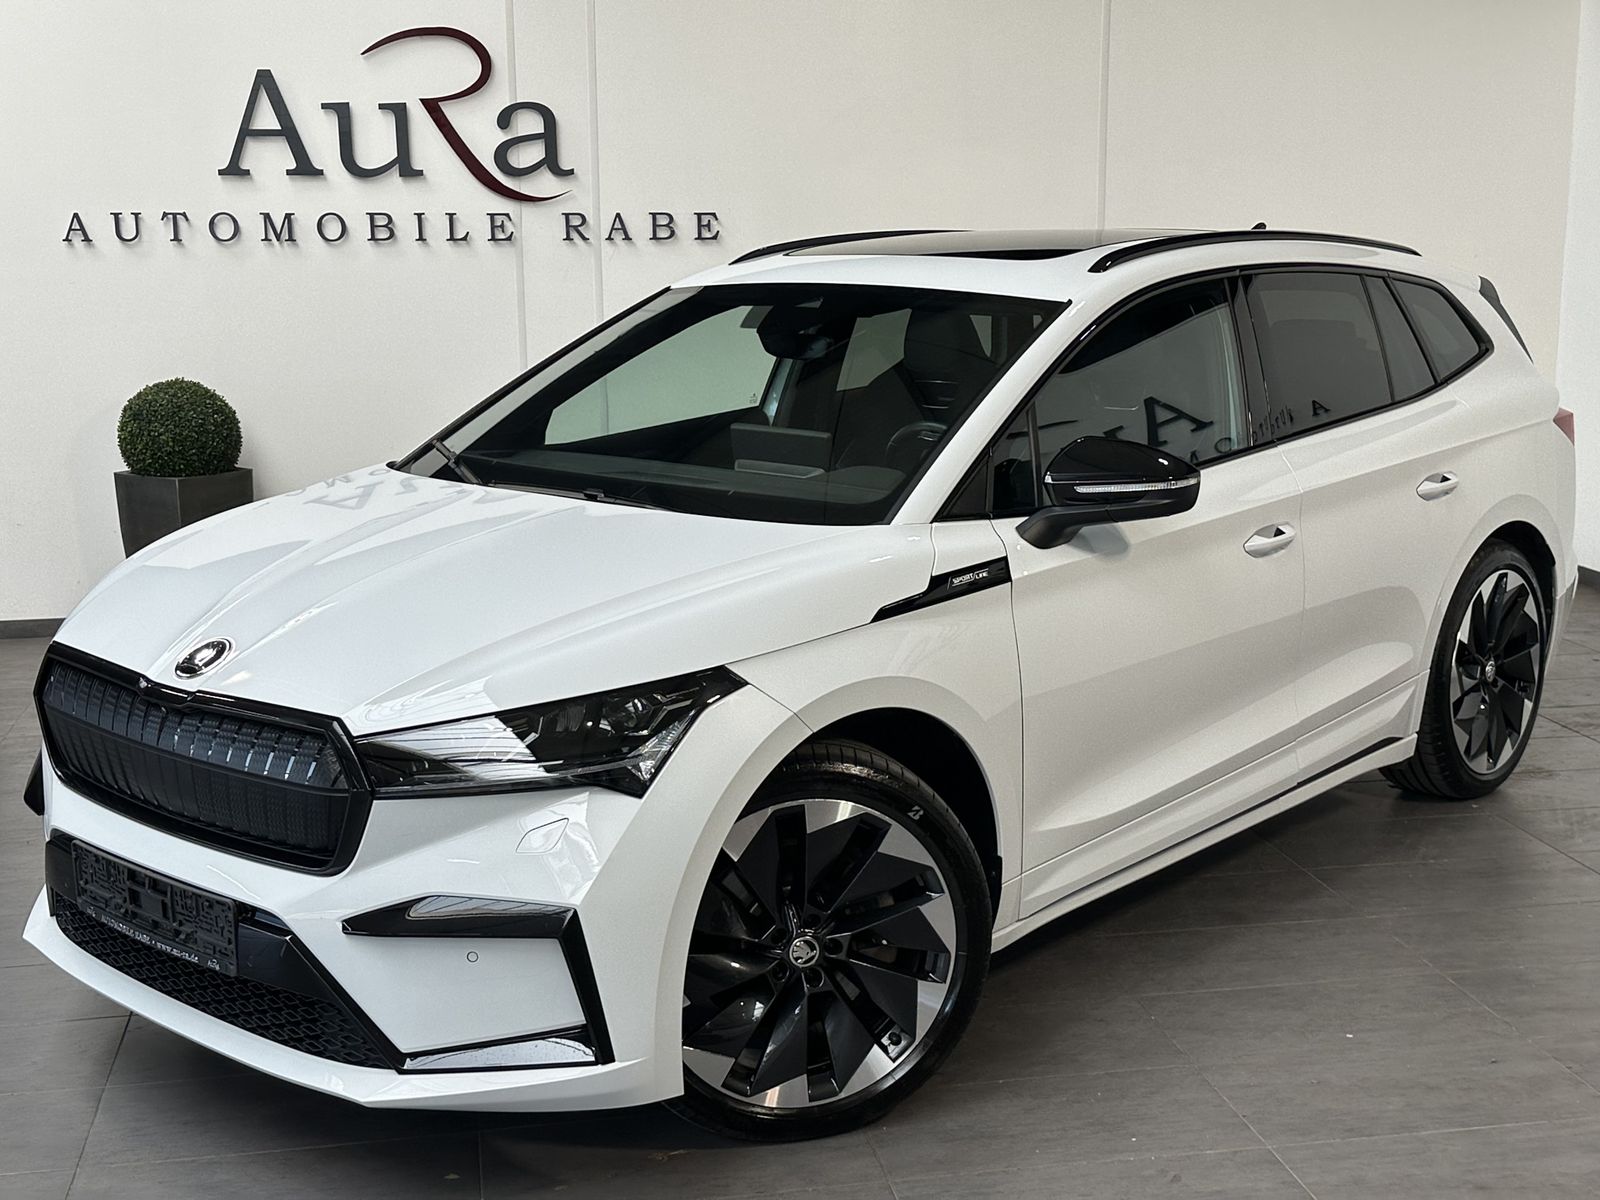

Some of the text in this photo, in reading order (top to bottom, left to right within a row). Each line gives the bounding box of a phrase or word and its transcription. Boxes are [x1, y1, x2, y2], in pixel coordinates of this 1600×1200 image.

[217, 26, 575, 203] AuRa
[62, 211, 721, 243] AUTOMOBILE RABE
